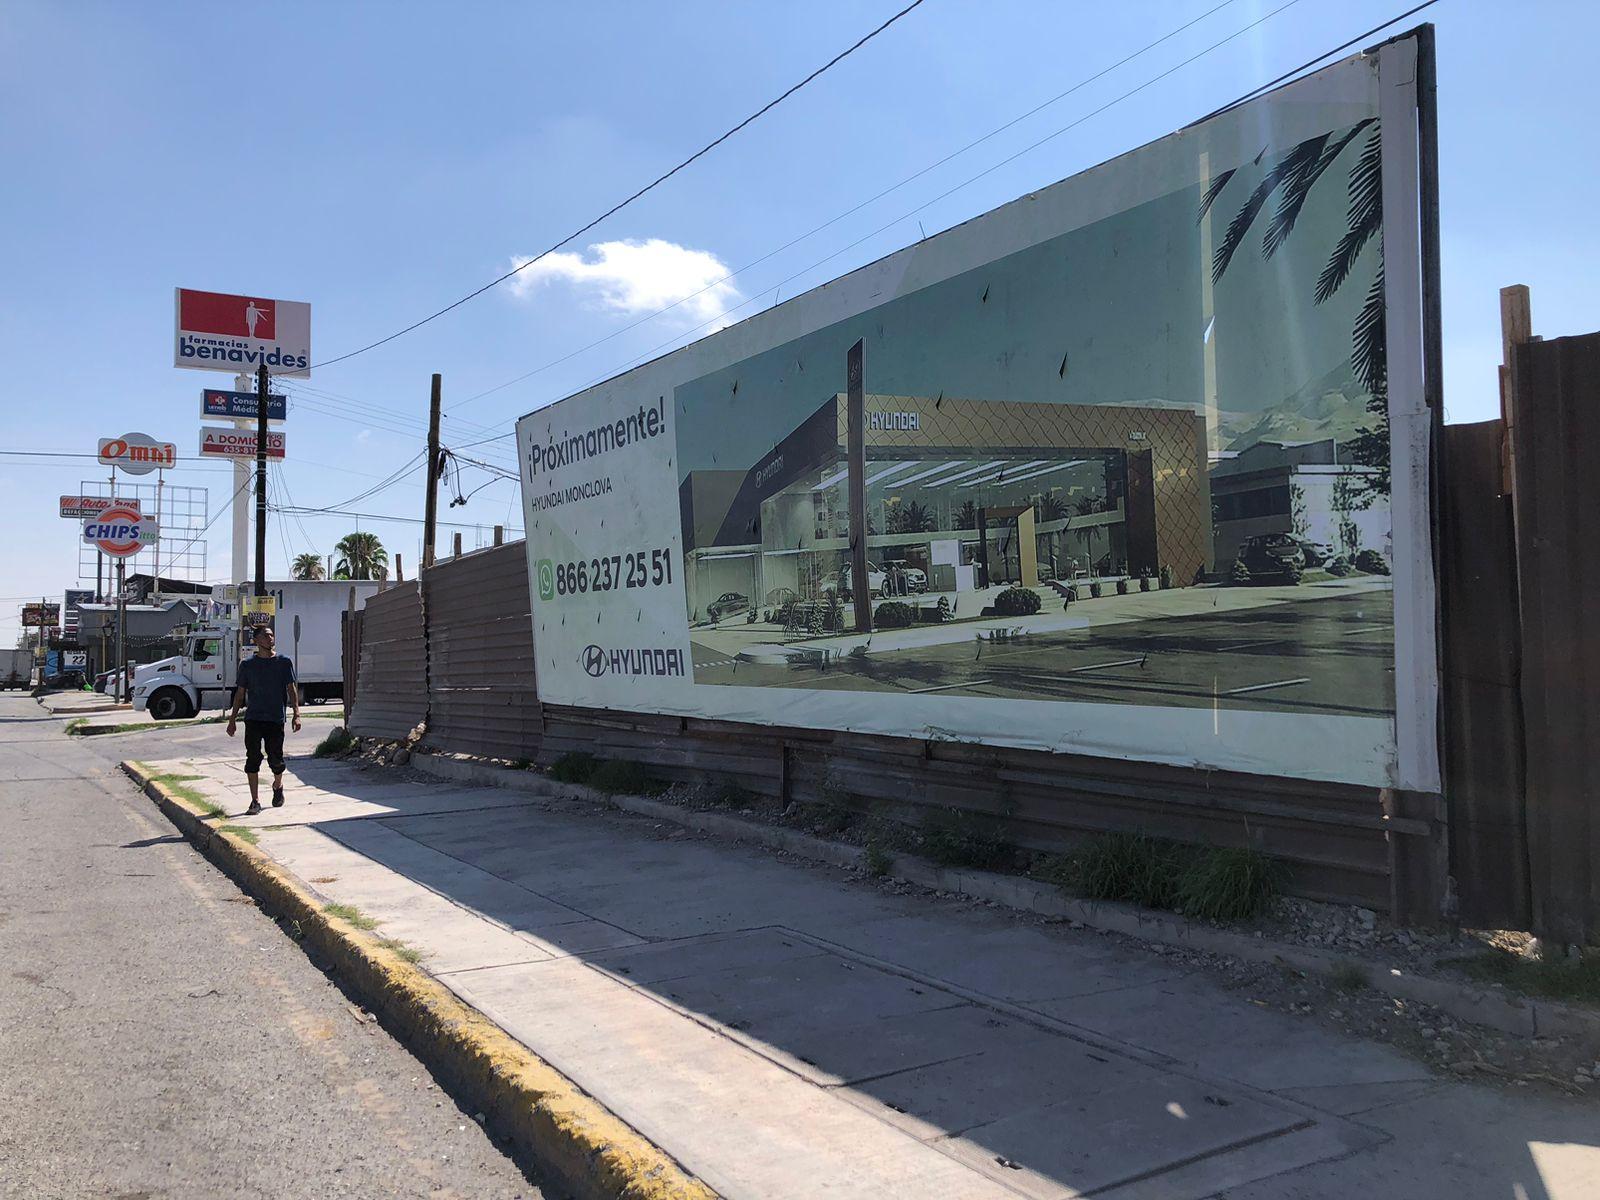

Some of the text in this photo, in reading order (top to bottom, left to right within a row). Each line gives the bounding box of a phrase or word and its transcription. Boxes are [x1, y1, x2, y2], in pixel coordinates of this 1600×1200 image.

[180, 337, 307, 368] benavides
[188, 335, 248, 349] farmacias
[232, 396, 282, 408] Consurio
[232, 405, 259, 414] Médic
[870, 412, 920, 430] HYUNDAI
[205, 434, 282, 448] A DOMICIO
[528, 396, 666, 484] ¡Próximamente!
[531, 477, 613, 512] HYUNDAI MONCLOVA
[556, 548, 672, 595] 866 237 25 51
[609, 649, 685, 676] HYUNDAI
